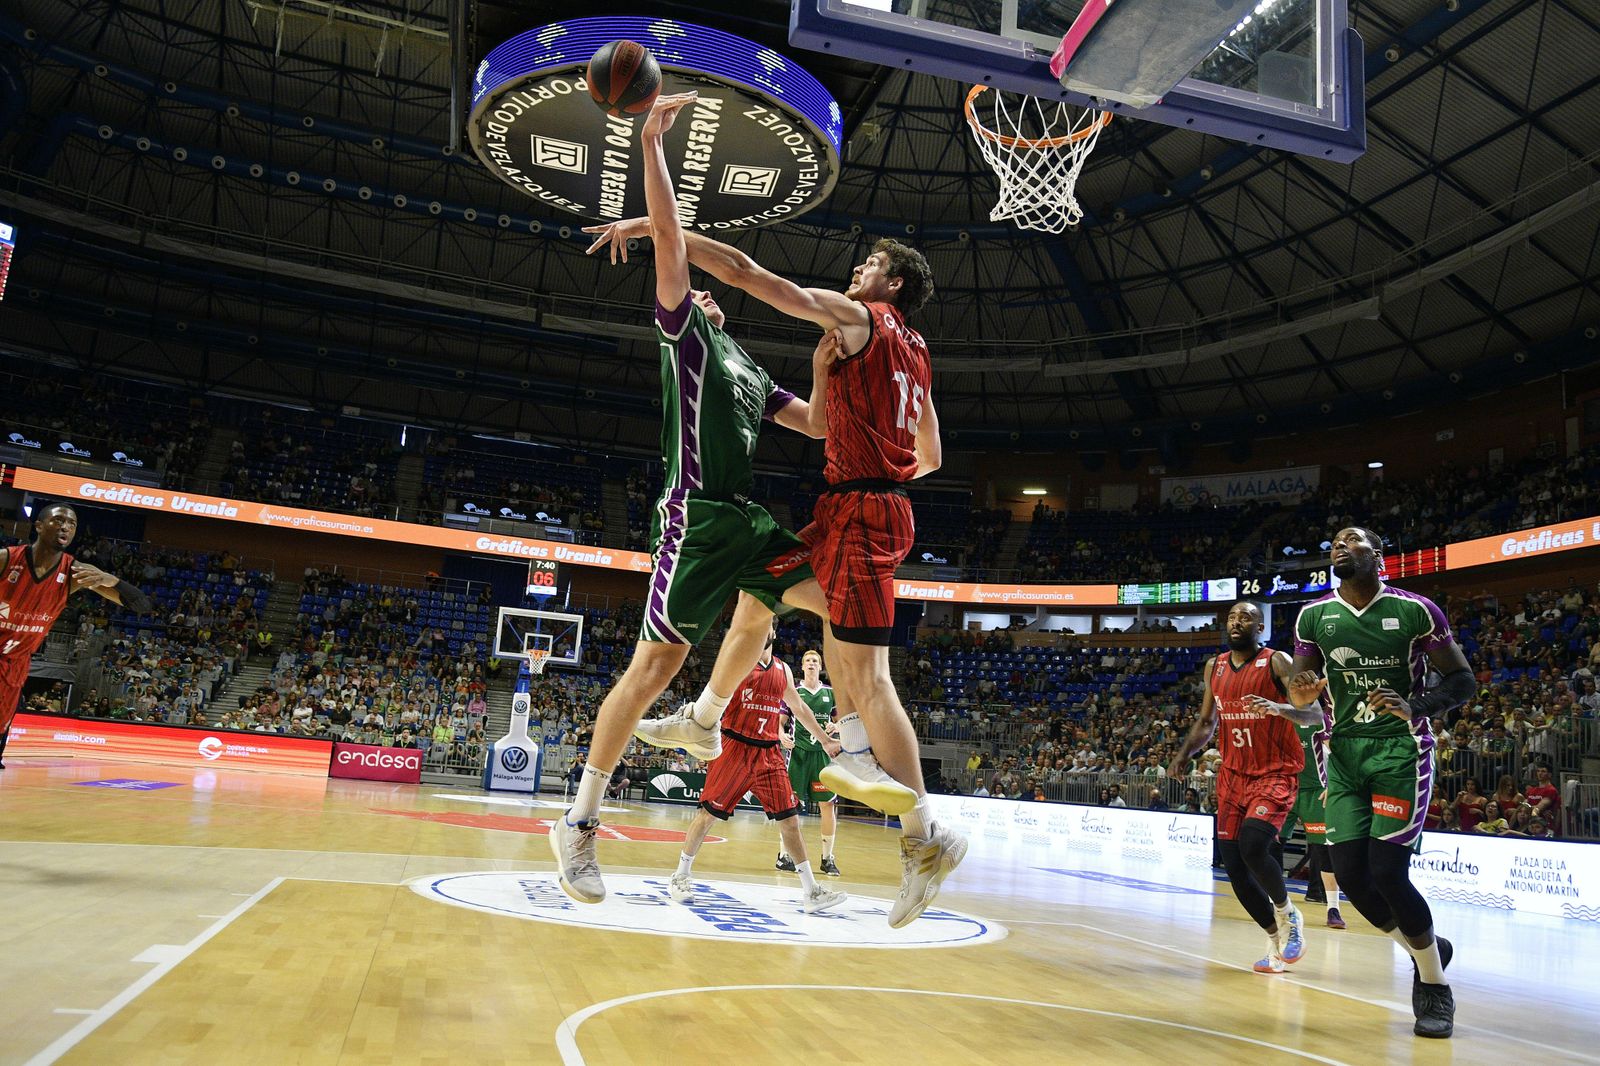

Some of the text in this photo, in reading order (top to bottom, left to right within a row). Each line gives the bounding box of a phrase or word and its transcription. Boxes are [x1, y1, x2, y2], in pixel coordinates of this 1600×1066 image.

[682, 97, 724, 172] RESERVA
[486, 76, 589, 212] PORTICO DE VELAZQUEZ
[742, 104, 819, 188] VELAZQUEZ
[603, 149, 630, 169] LA
[678, 174, 706, 191] LA
[598, 169, 628, 219] RESERVA
[783, 189, 812, 204] DE
[697, 204, 792, 231] PORTICO
[79, 482, 239, 518] Gráficas Urania
[266, 513, 374, 534] www.graficasurania.es
[476, 536, 613, 566] Gráficas Urania
[1501, 529, 1585, 556] Gráficas
[535, 560, 556, 570] 7:40
[533, 571, 555, 586] 06
[1242, 579, 1260, 595] 26
[1309, 570, 1327, 587] 28
[898, 583, 955, 600] Urania
[979, 589, 1073, 601] www.graficasurania.es
[1359, 655, 1400, 667] Unicaja
[1342, 671, 1391, 690] Málaga
[1353, 701, 1376, 724] 26
[757, 717, 767, 735] 7
[1231, 728, 1253, 748] 31
[337, 749, 419, 770] endesa
[493, 773, 514, 781] Málaga
[1514, 855, 1567, 870] PLAZA DE LA
[1509, 868, 1573, 885] MALAGUETA 4
[1504, 879, 1543, 894] ANTONIO
